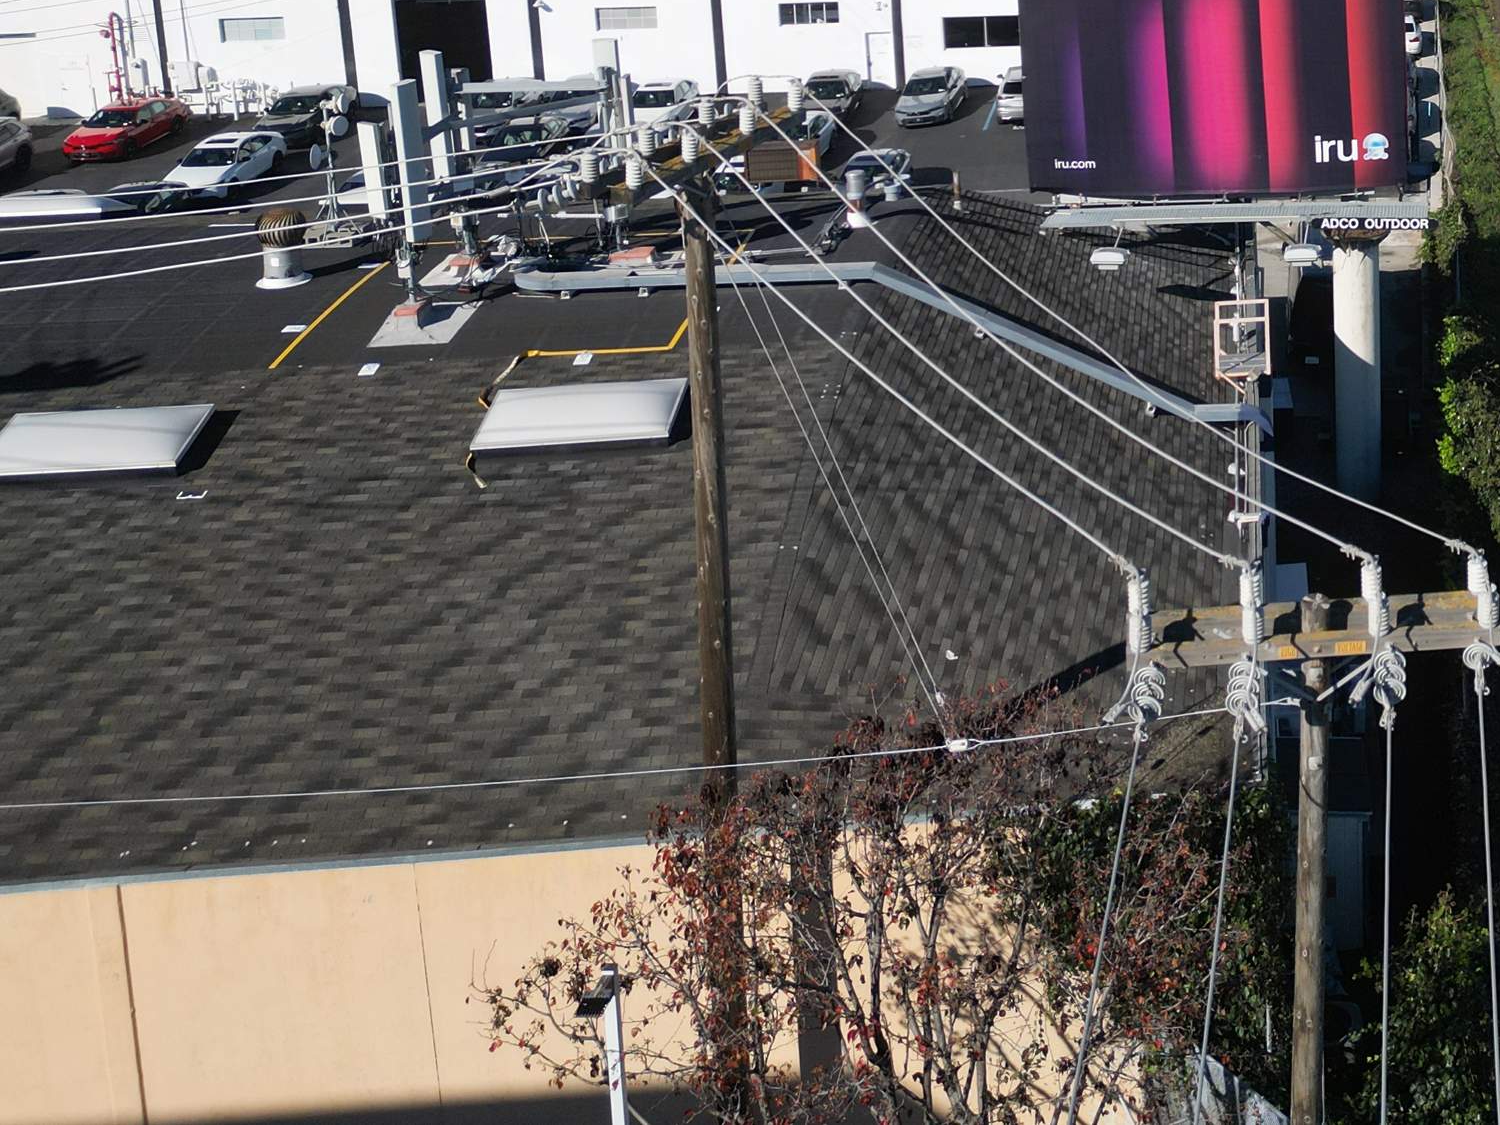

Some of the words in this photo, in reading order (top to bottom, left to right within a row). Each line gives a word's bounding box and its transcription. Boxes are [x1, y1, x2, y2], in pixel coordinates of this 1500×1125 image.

[1314, 135, 1359, 163] iru
[1054, 158, 1096, 169] iru.com
[1321, 218, 1359, 229] ADCO
[1364, 218, 1429, 230] OUTDOOR
